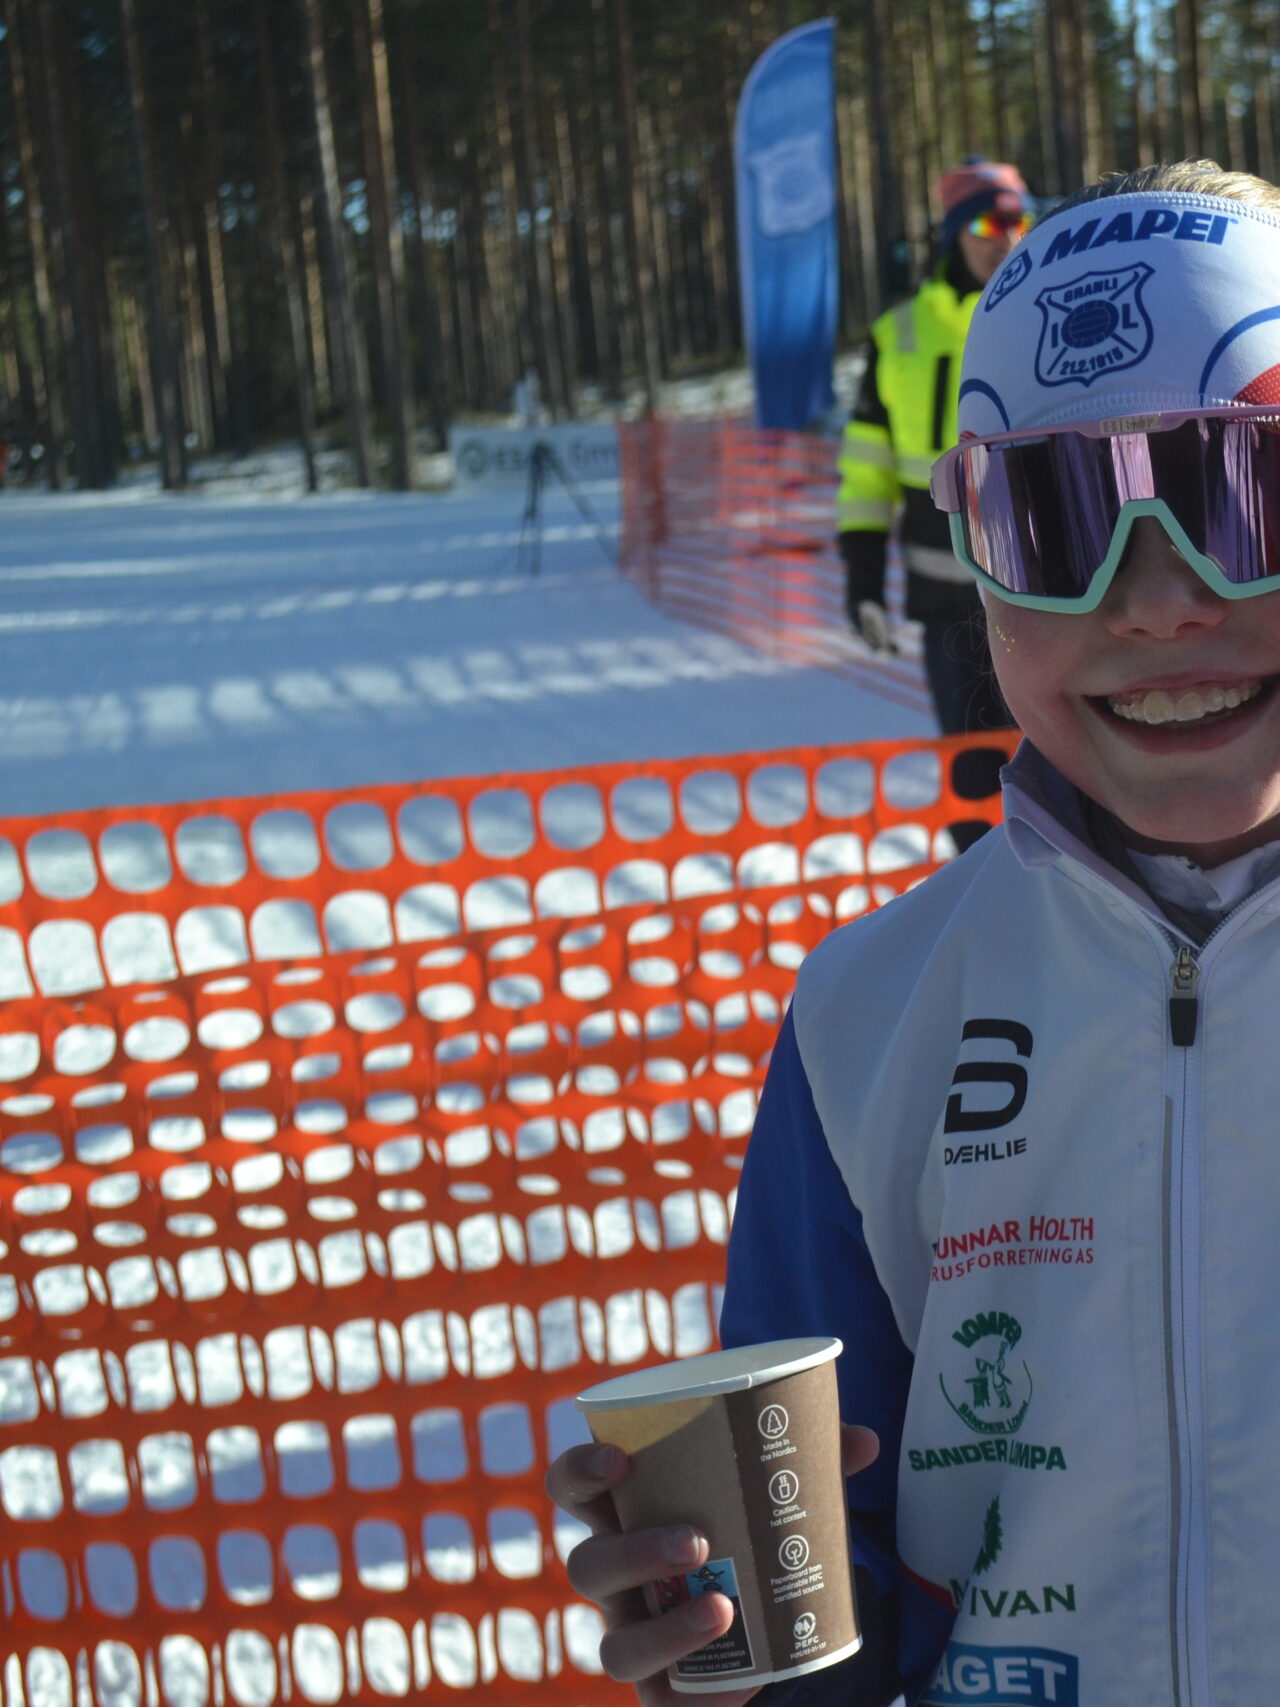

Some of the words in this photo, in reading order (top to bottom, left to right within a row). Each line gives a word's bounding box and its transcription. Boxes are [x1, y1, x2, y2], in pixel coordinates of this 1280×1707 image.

[1040, 209, 1229, 268] MAPEI
[1063, 277, 1118, 303] GRANLI
[944, 1137, 1028, 1166] DÆHLIE
[932, 1219, 1022, 1260] UNNAR
[1029, 1215, 1095, 1242] HOLTH
[762, 1440, 783, 1452] Made
[772, 1446, 797, 1459] Nordics
[907, 1438, 1008, 1472] SANDER
[795, 1635, 820, 1650] PEFC
